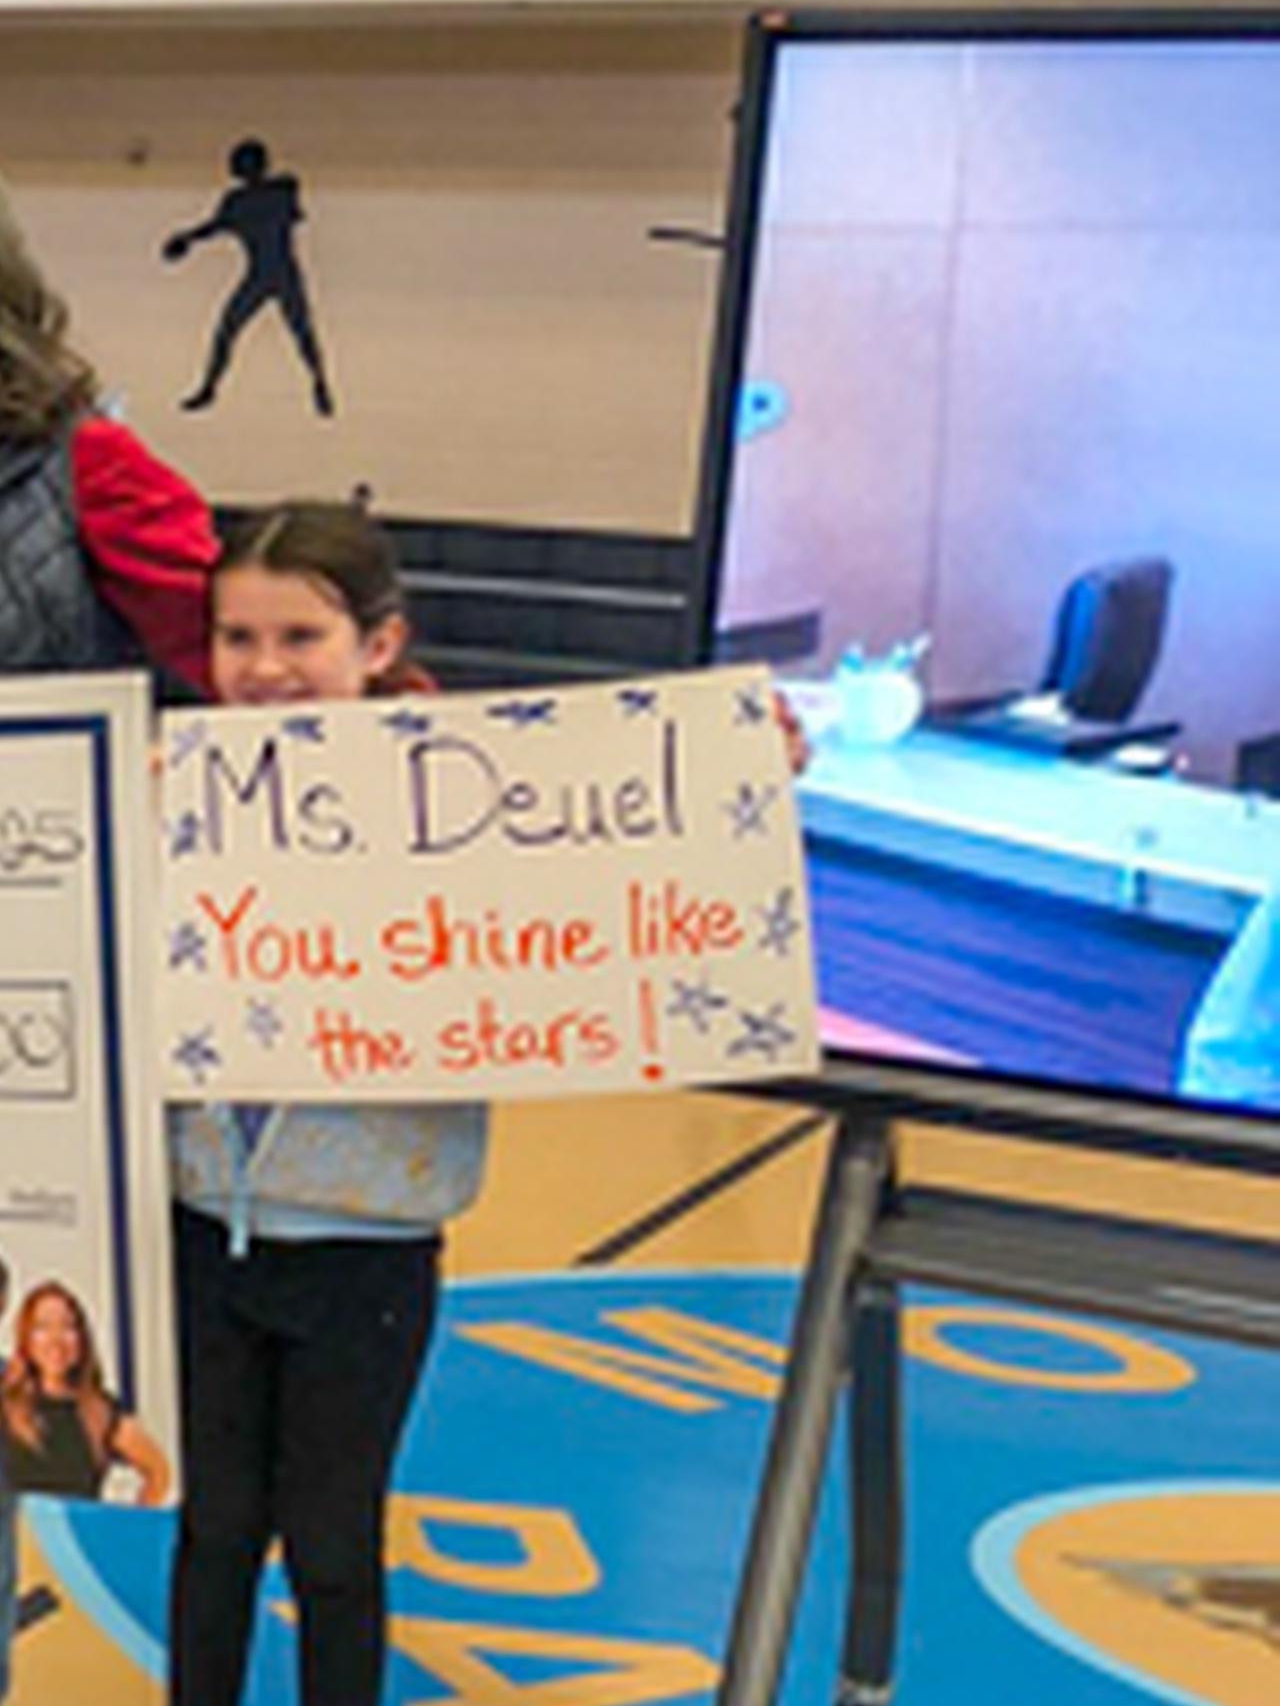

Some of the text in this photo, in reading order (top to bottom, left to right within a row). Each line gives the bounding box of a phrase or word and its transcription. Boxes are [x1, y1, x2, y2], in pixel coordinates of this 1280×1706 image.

[199, 718, 684, 855] Ms. Deuel
[196, 879, 746, 981] You shine like
[308, 1005, 414, 1083] the
